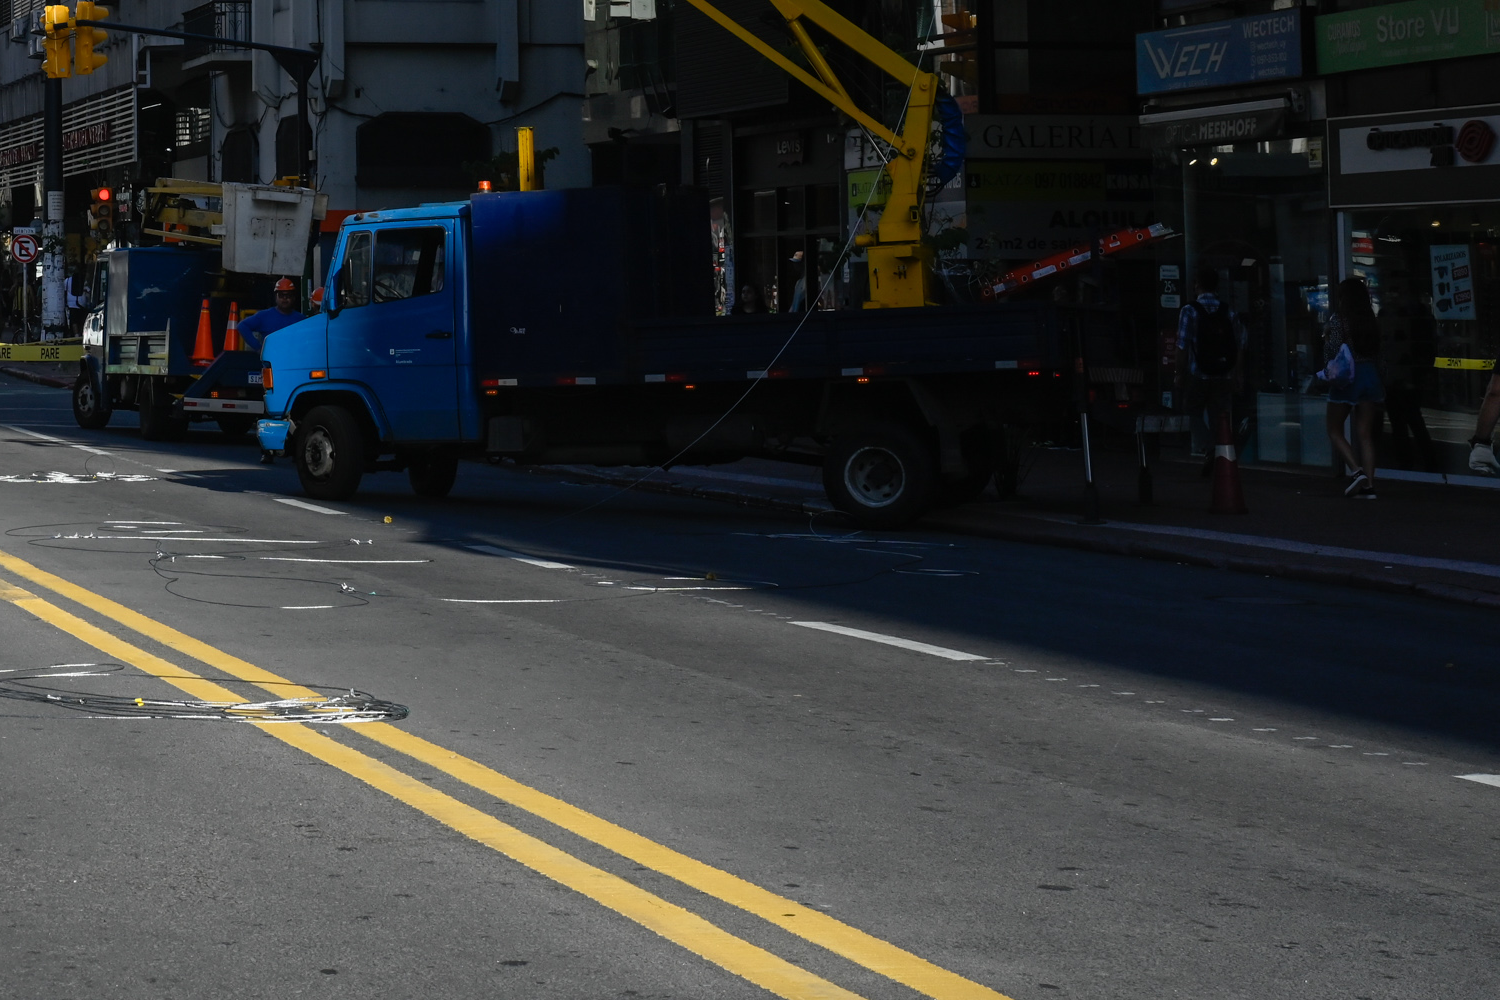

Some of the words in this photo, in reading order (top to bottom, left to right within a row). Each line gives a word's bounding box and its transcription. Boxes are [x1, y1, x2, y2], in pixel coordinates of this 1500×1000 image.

[1243, 15, 1295, 38] WECTECH
[1376, 15, 1425, 43] Store
[1143, 39, 1228, 79] WECH
[982, 119, 1120, 148] GALERÍA
[1199, 117, 1257, 140] MEERHOFF
[983, 174, 1025, 186] KATZ
[1035, 173, 1055, 189] 097
[1060, 173, 1102, 189] 018842
[1031, 237, 1047, 250] de
[1434, 250, 1467, 263] POLARIZADOS
[40, 348, 60, 359] PARE
